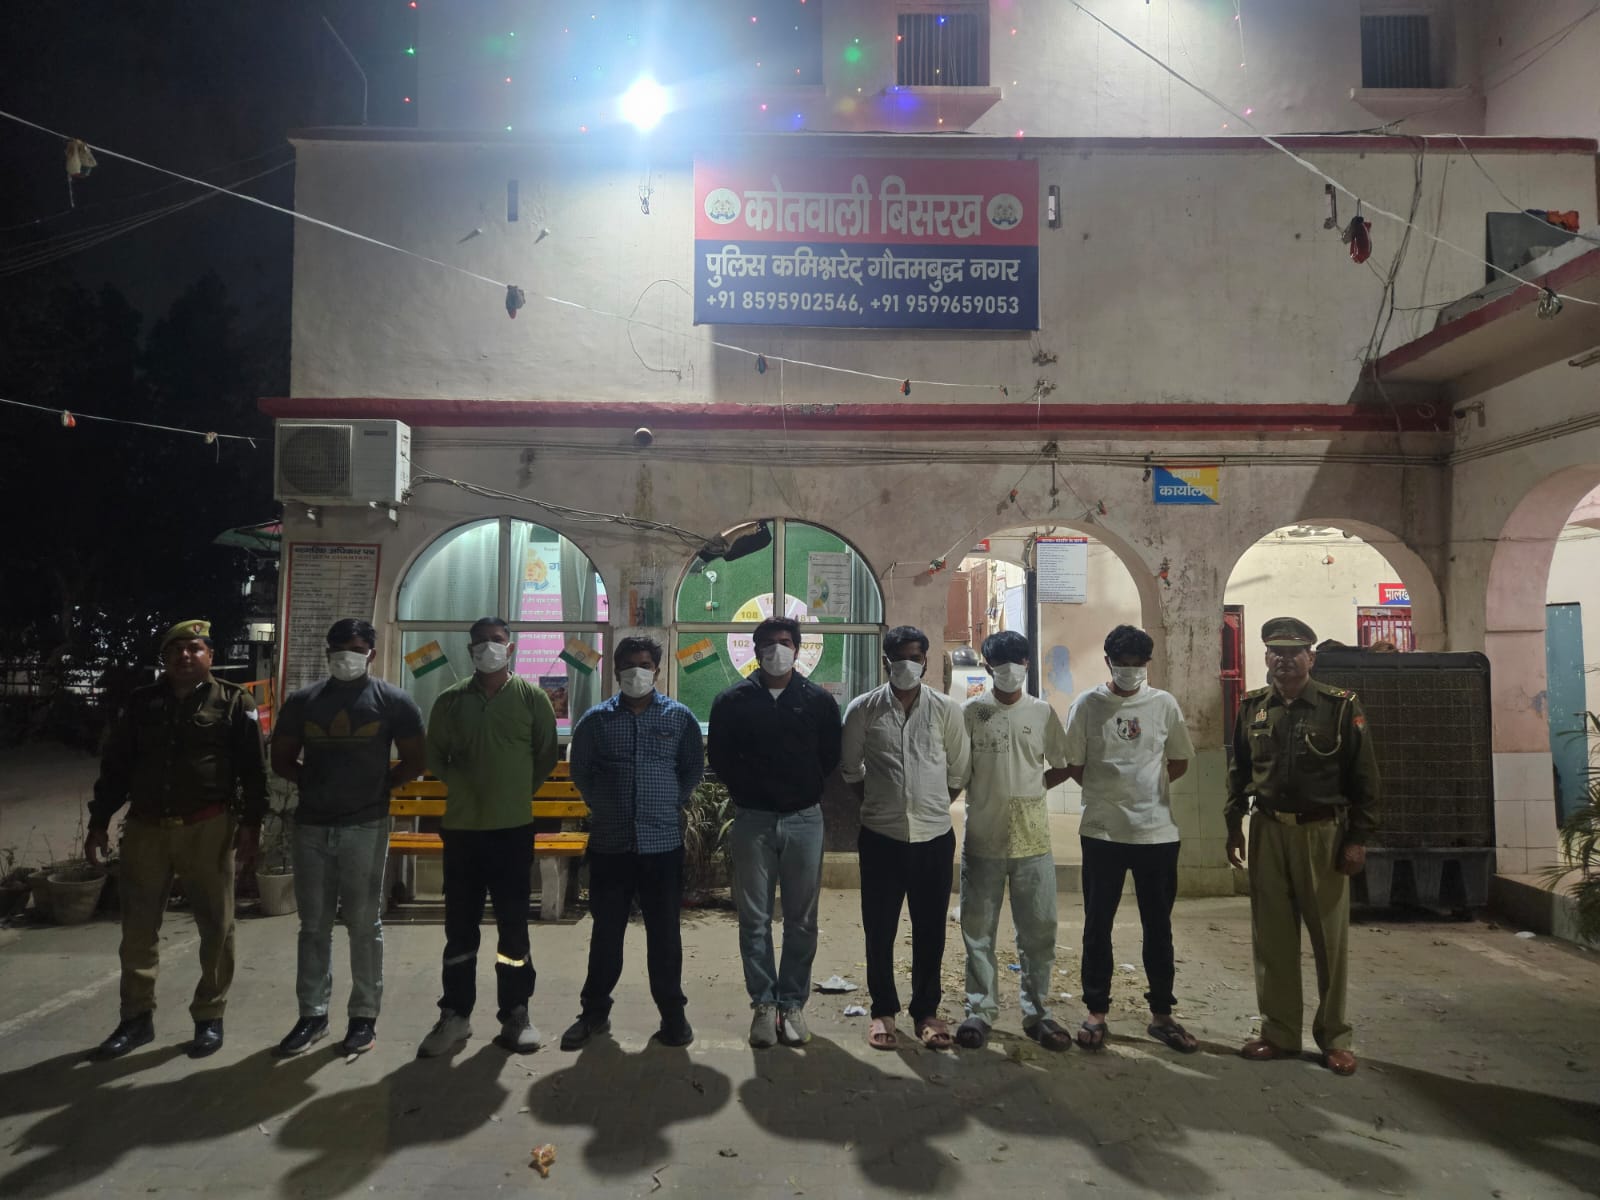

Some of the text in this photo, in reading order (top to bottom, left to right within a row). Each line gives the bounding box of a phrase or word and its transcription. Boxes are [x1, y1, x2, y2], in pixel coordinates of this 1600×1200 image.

[743, 173, 984, 238] कोतवाली बिसरख
[705, 244, 767, 288] पुलिस
[867, 247, 965, 293] गौतमबुद्ध
[969, 258, 1021, 282] नगर
[706, 290, 1020, 316] +91 8595902546, +91 9599659053
[1158, 482, 1213, 497] कार्यालय
[733, 639, 750, 648] 102
